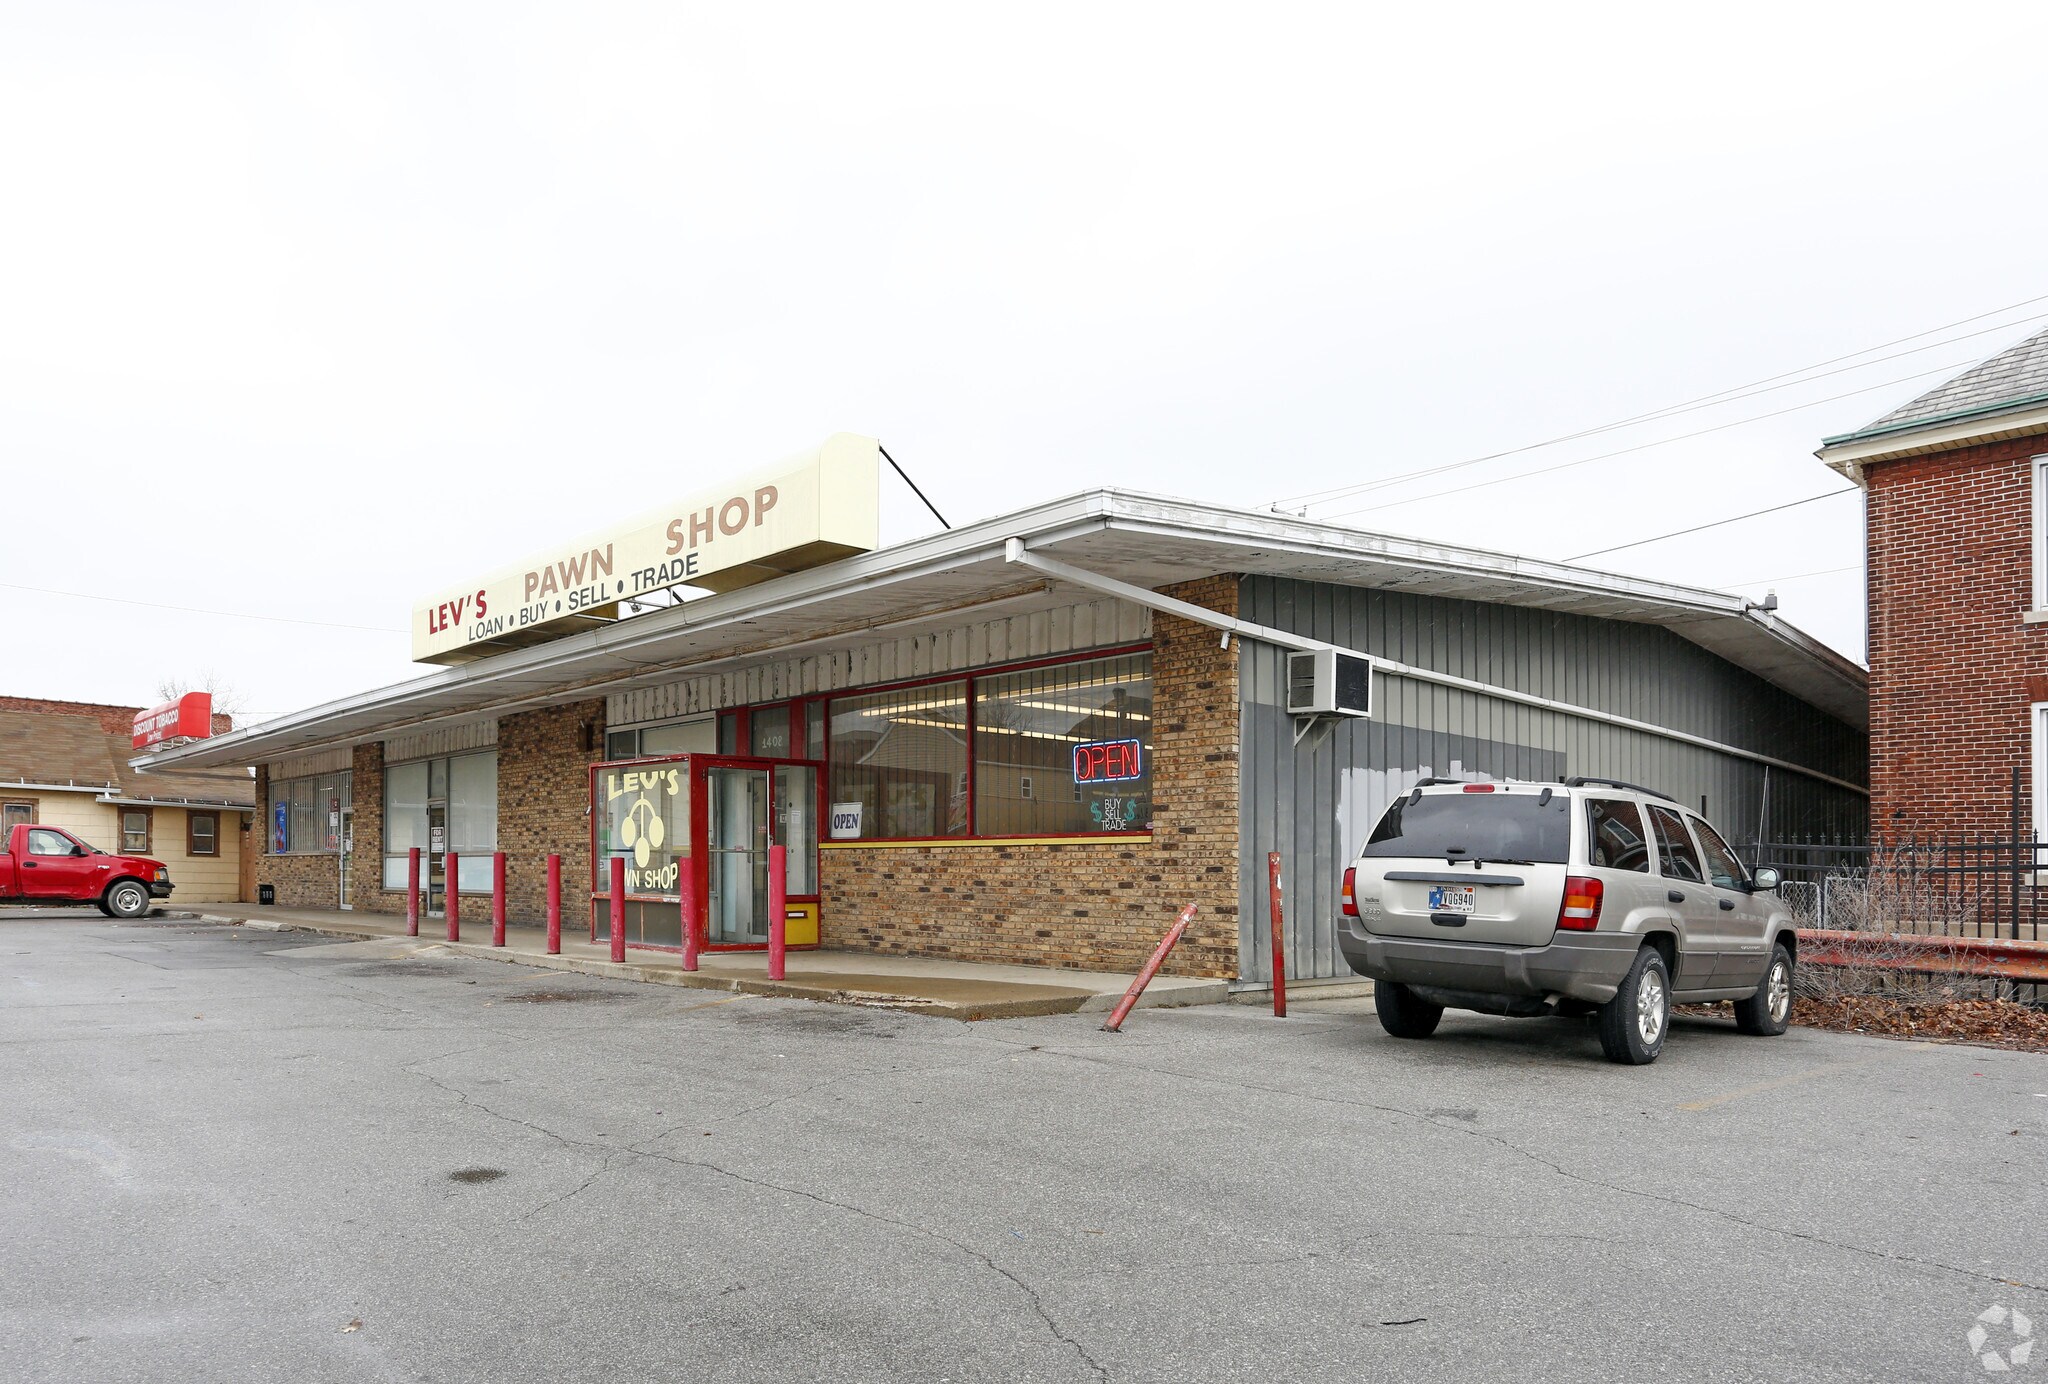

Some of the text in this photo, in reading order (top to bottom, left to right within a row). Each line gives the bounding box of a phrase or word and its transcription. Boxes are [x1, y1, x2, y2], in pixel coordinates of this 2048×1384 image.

[429, 485, 779, 635] LEV'S PAWN SHOP
[468, 552, 699, 642] LOAN BUY SELL TRADE
[133, 709, 178, 736] DISCOUNT TOBACCO
[762, 736, 783, 749] 1408
[1076, 744, 1137, 779] OPEN
[608, 769, 679, 802] LEV'S
[1104, 798, 1122, 810] BUY
[1104, 809, 1122, 820] SELL
[833, 812, 859, 830] OPEN
[1101, 819, 1127, 831] TRADE
[644, 862, 678, 889] SHOP
